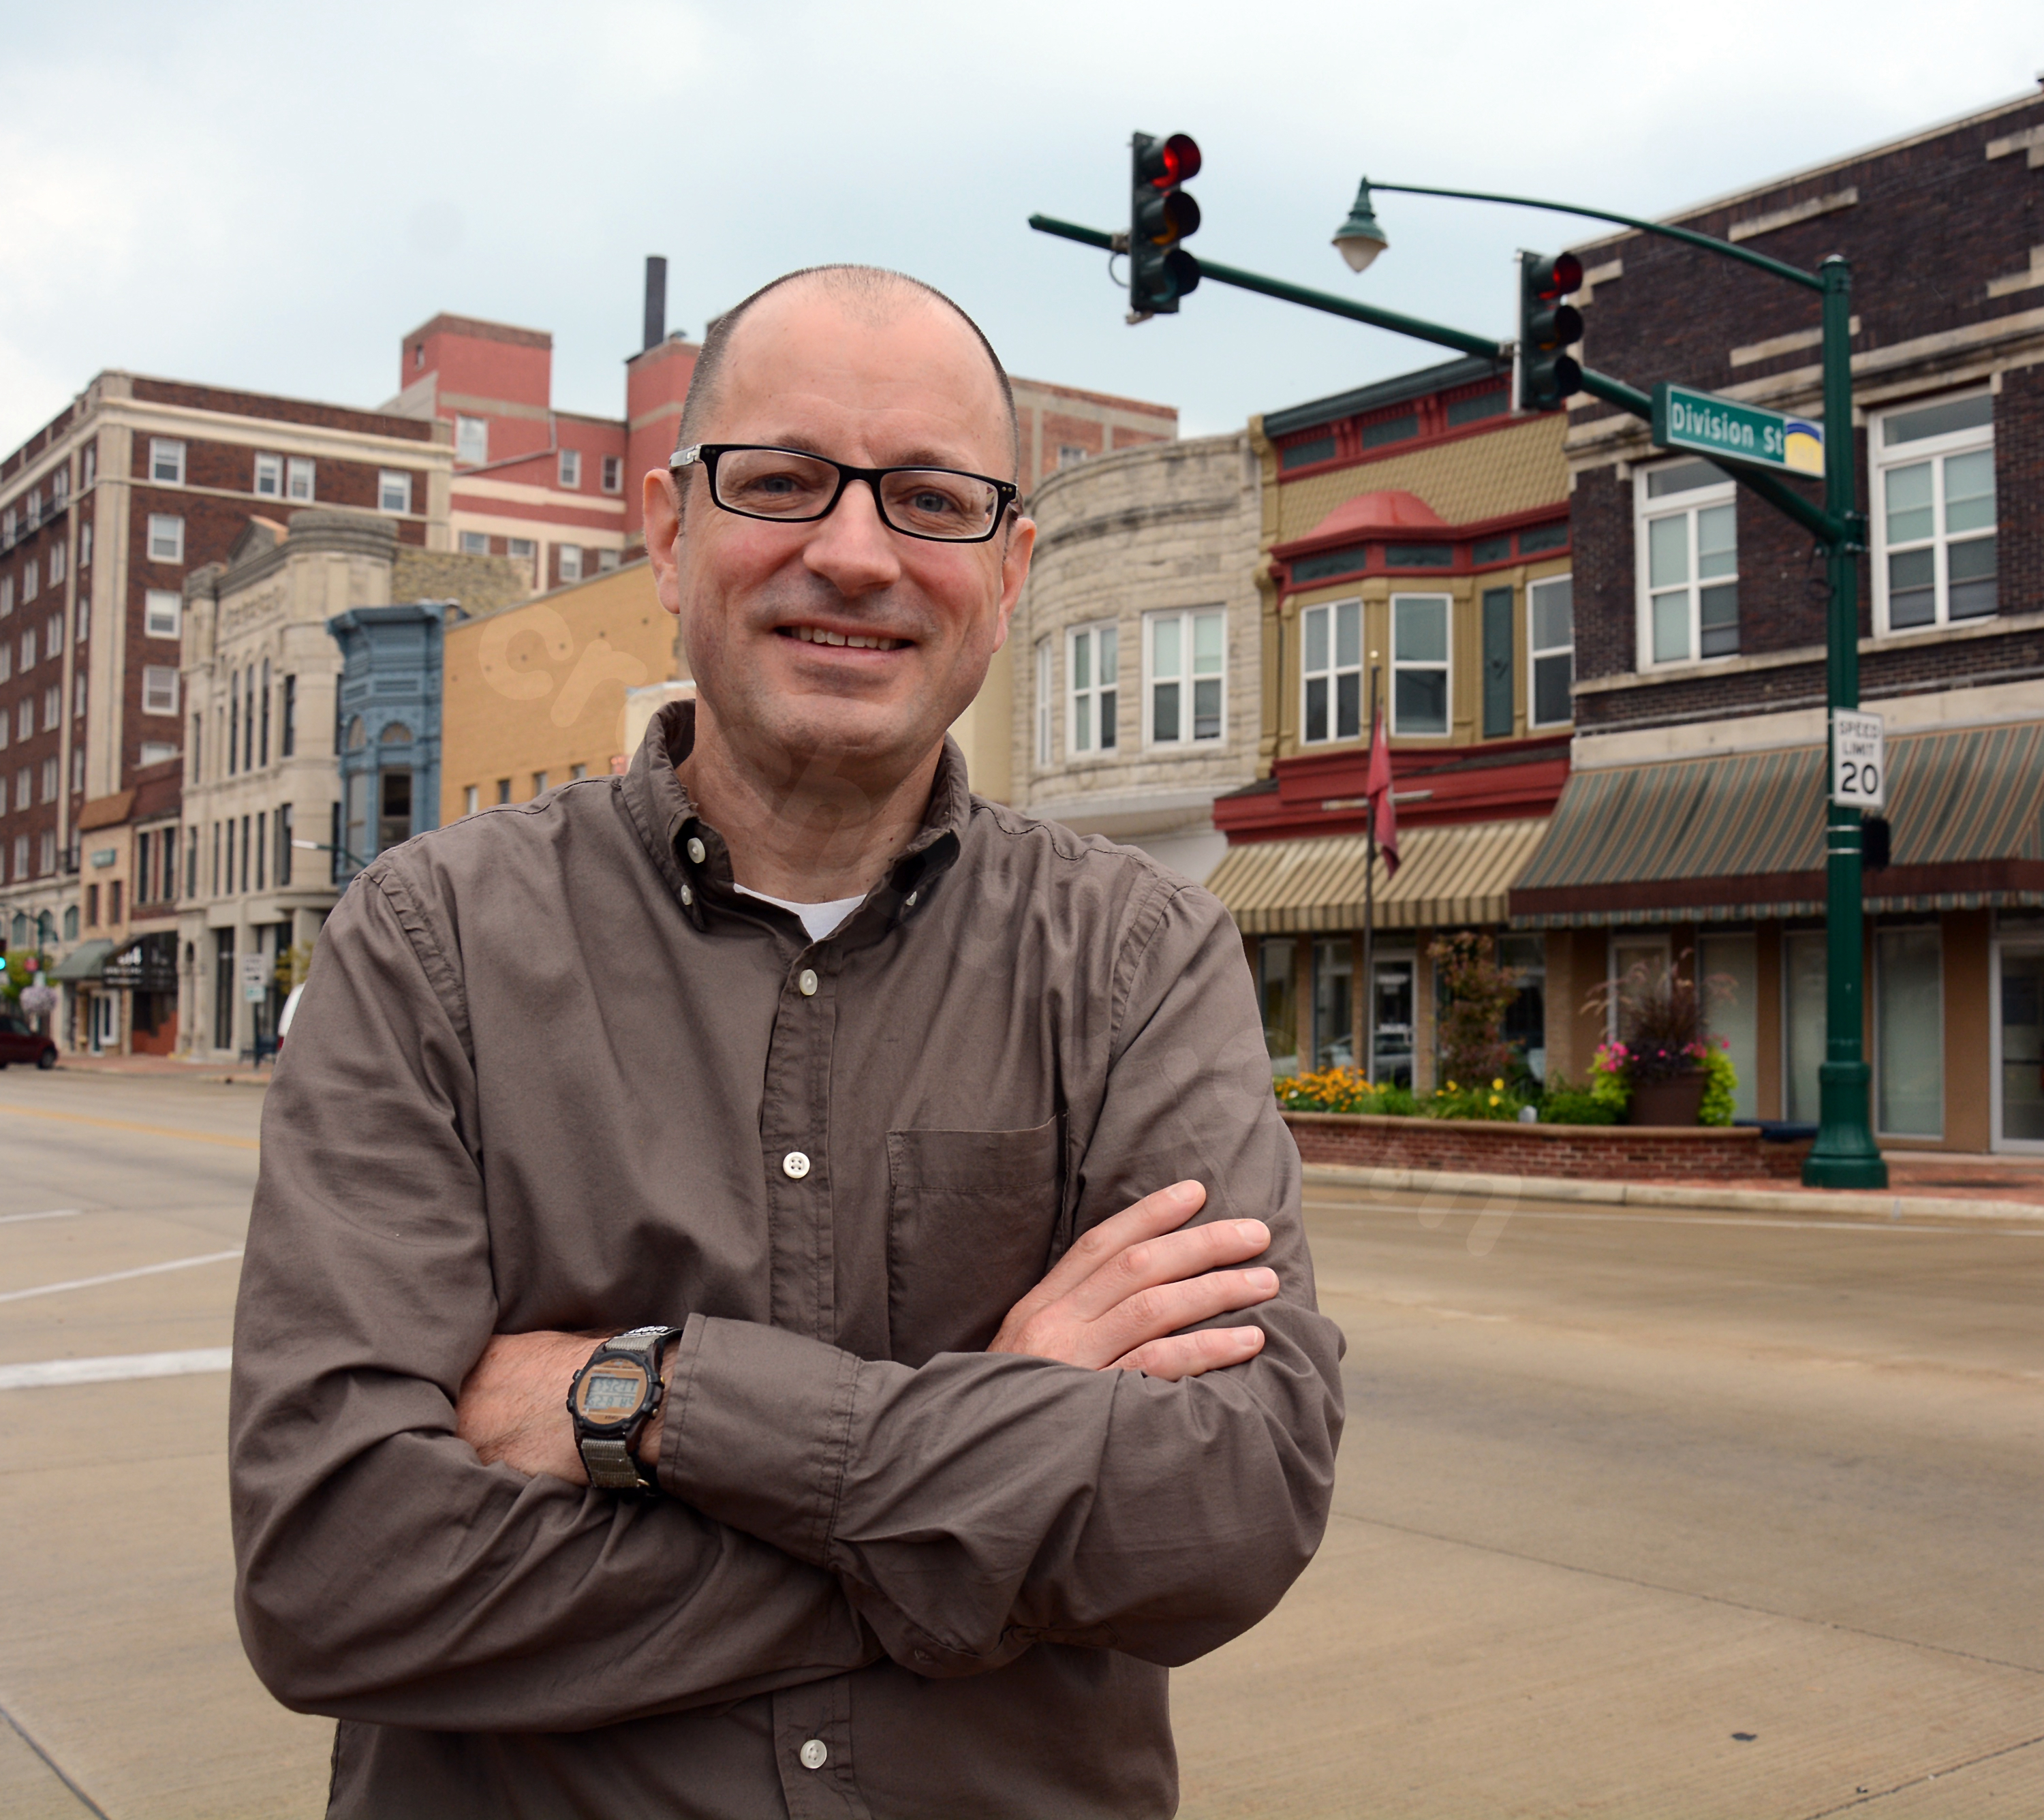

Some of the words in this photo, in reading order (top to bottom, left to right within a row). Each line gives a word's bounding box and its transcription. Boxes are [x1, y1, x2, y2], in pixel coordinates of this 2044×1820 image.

[1671, 401, 1754, 448] Division
[1763, 425, 1784, 455] St
[1839, 720, 1879, 739] SPEED
[1842, 741, 1874, 757] LIMIT
[1842, 762, 1878, 795] 20
